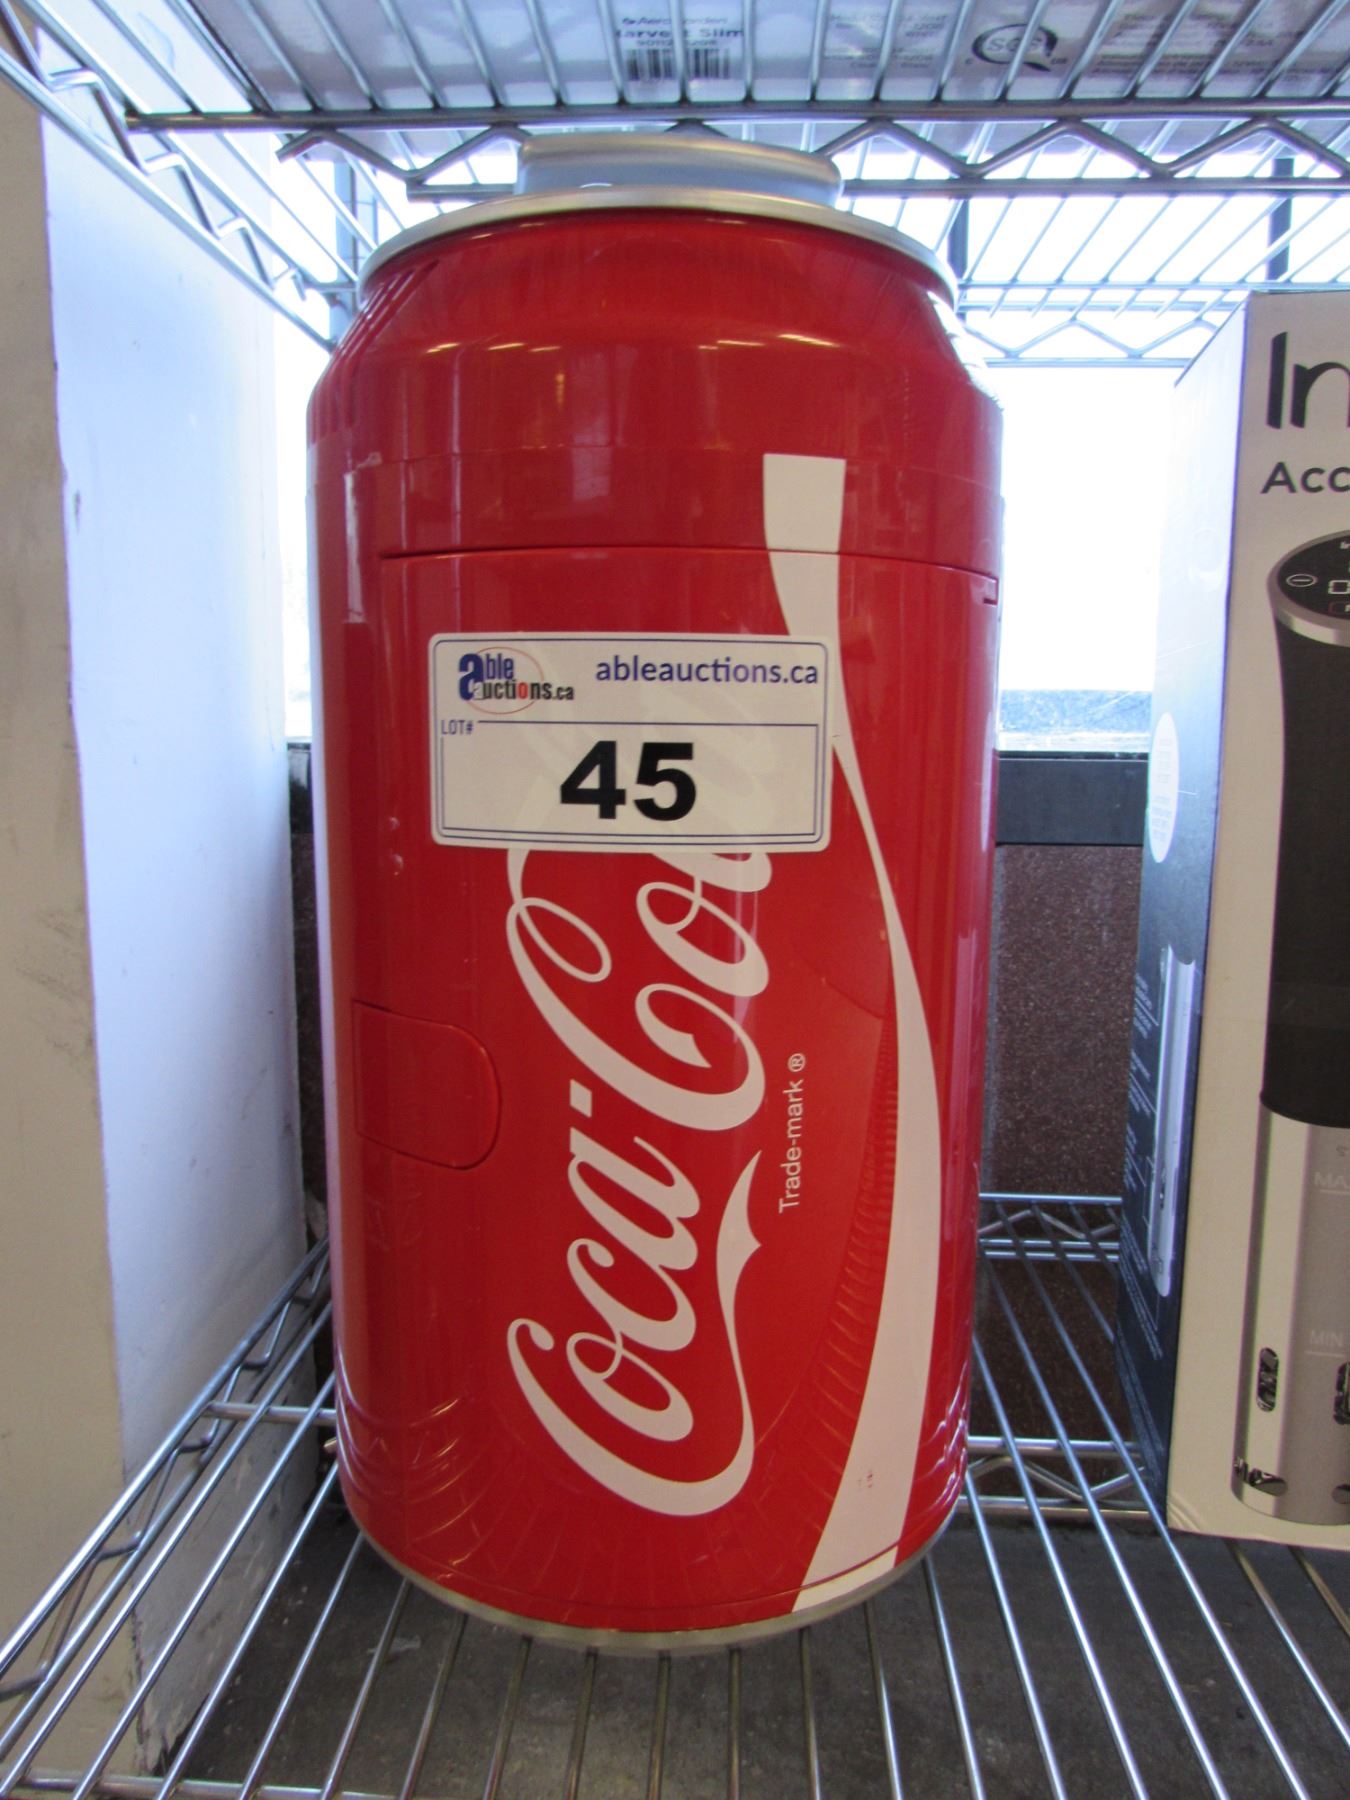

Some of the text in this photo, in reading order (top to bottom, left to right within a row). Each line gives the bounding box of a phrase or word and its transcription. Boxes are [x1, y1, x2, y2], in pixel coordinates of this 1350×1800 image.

[458, 653, 514, 700] able
[596, 655, 818, 684] ableauctions.ca
[441, 719, 473, 735] LOT#
[560, 740, 697, 821] 45
[778, 1078, 804, 1214] Trade-mark
[506, 848, 773, 1516] Coca-Co
[1313, 1171, 1350, 1188] MA
[1308, 1329, 1344, 1348] MIN
